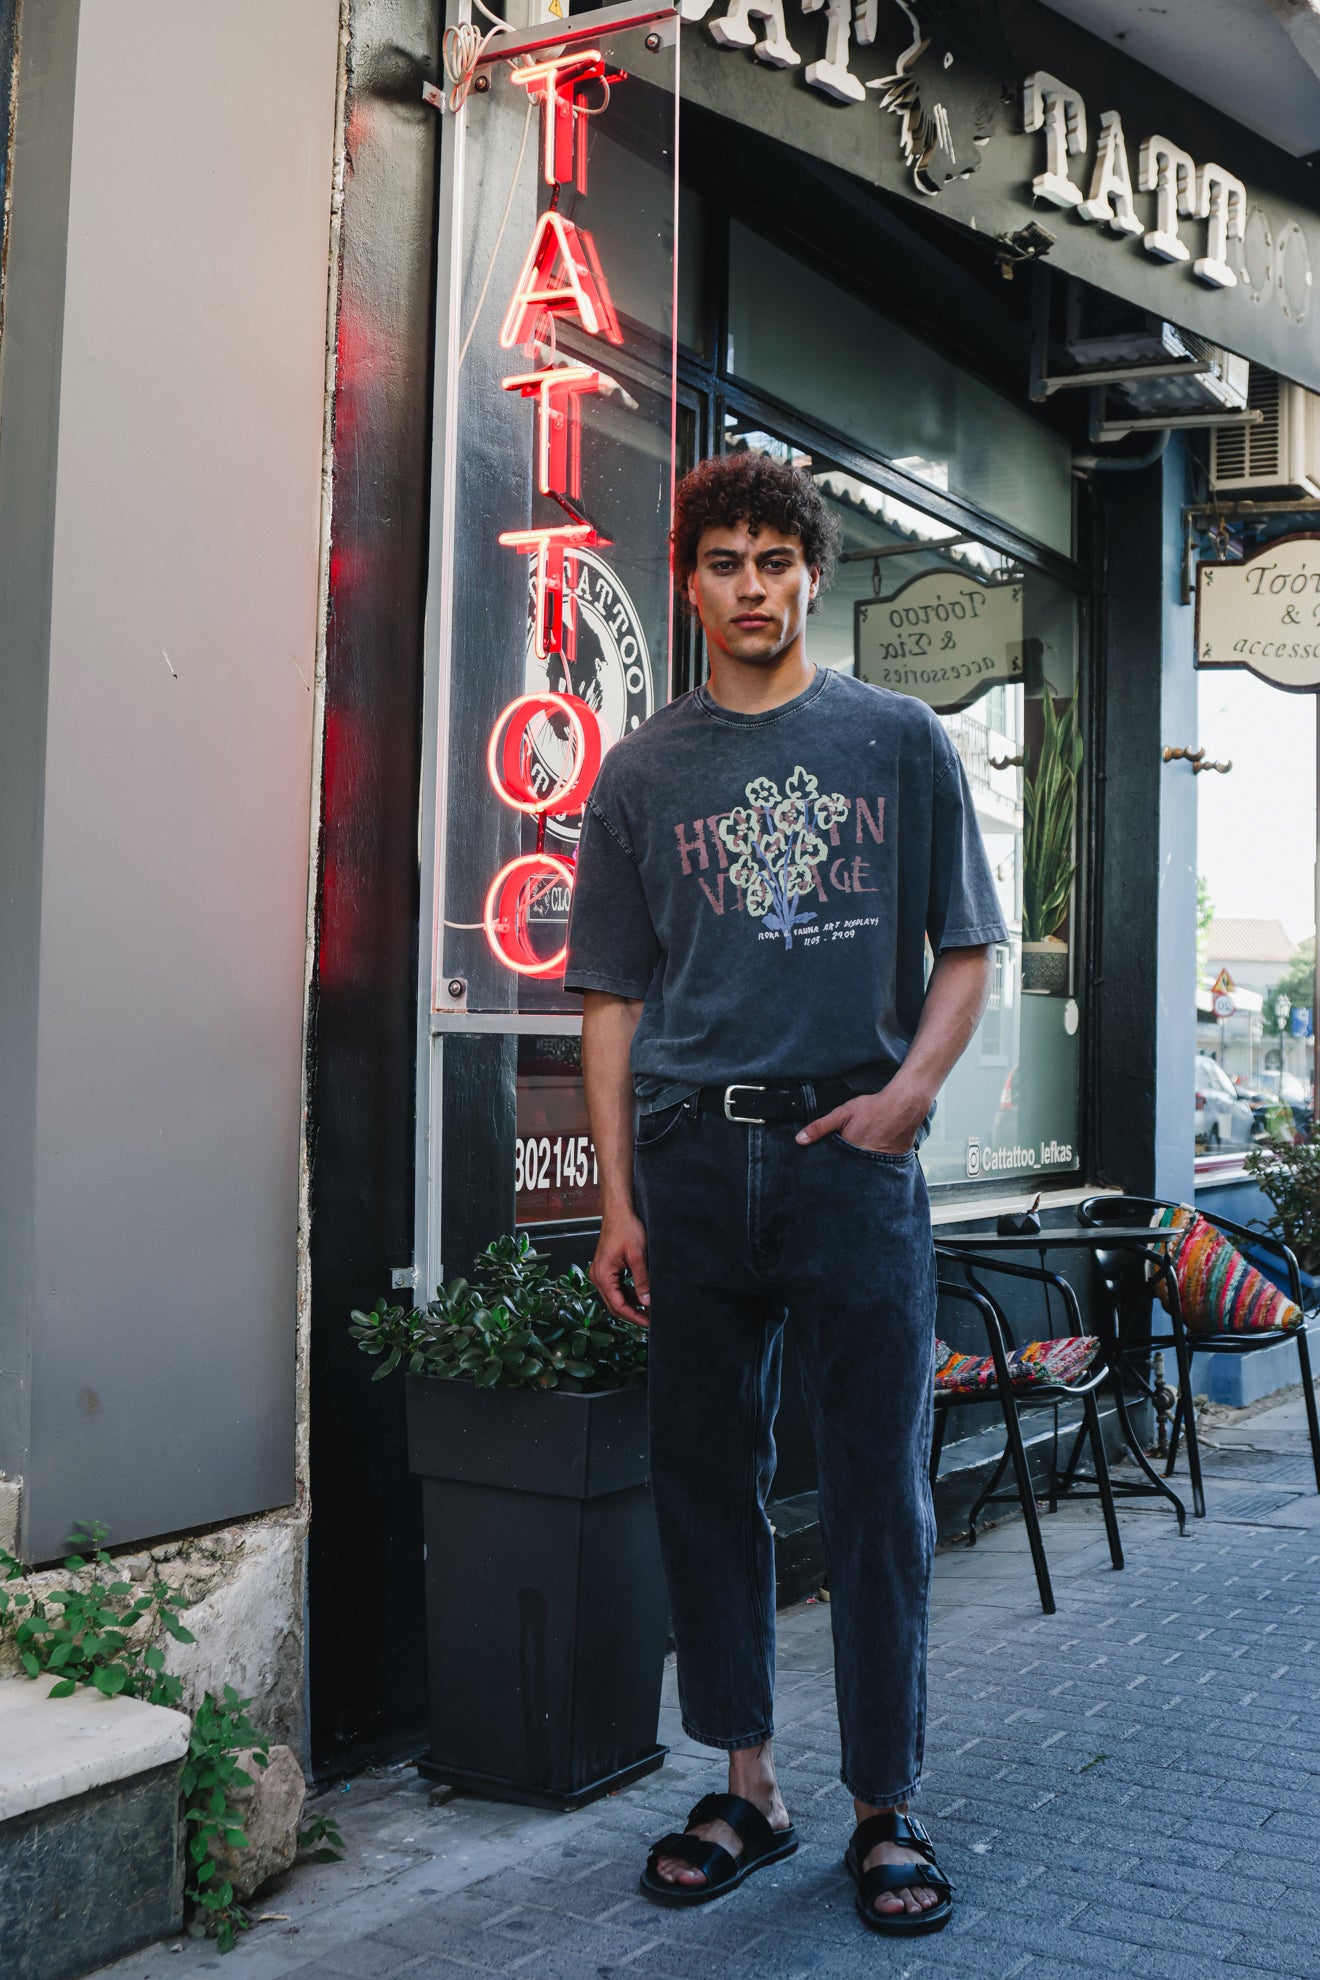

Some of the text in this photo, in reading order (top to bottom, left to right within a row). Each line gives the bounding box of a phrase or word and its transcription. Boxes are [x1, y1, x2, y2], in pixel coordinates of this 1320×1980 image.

[485, 50, 602, 975] TATTOO
[1281, 604, 1300, 625] &
[758, 930, 780, 940] FLORA
[794, 926, 819, 935] FAUNA
[823, 921, 841, 932] ART
[844, 917, 879, 928] DISPLAYS
[982, 1140, 1073, 1171] Cattattoo_lefkas
